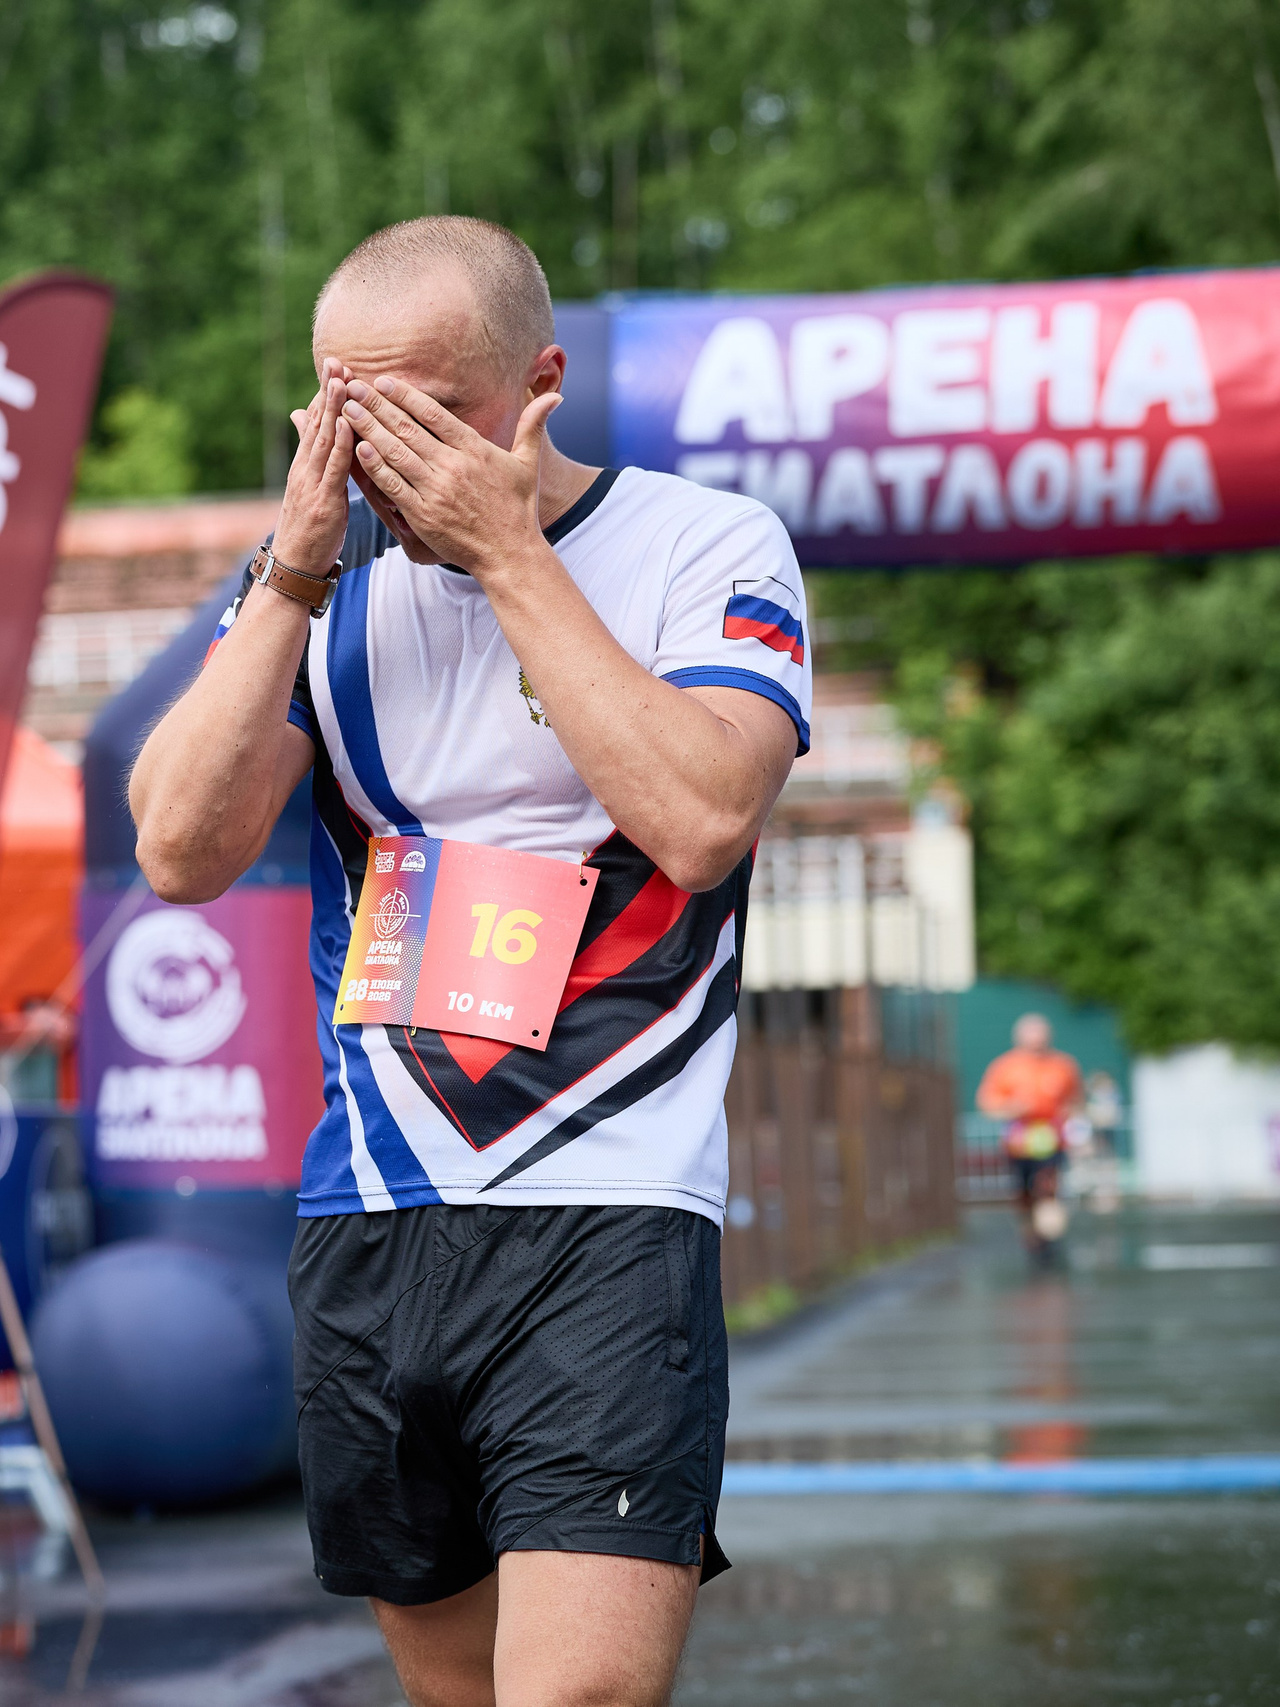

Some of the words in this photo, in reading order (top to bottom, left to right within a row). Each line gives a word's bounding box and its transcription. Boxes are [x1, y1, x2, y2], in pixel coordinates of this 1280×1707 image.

[673, 298, 1220, 445] АРЕНА
[469, 902, 544, 965] 16
[368, 940, 402, 955] АРЕНА
[345, 979, 368, 1002] 28
[369, 979, 402, 990] ИЮНЯ
[447, 991, 474, 1013] 10
